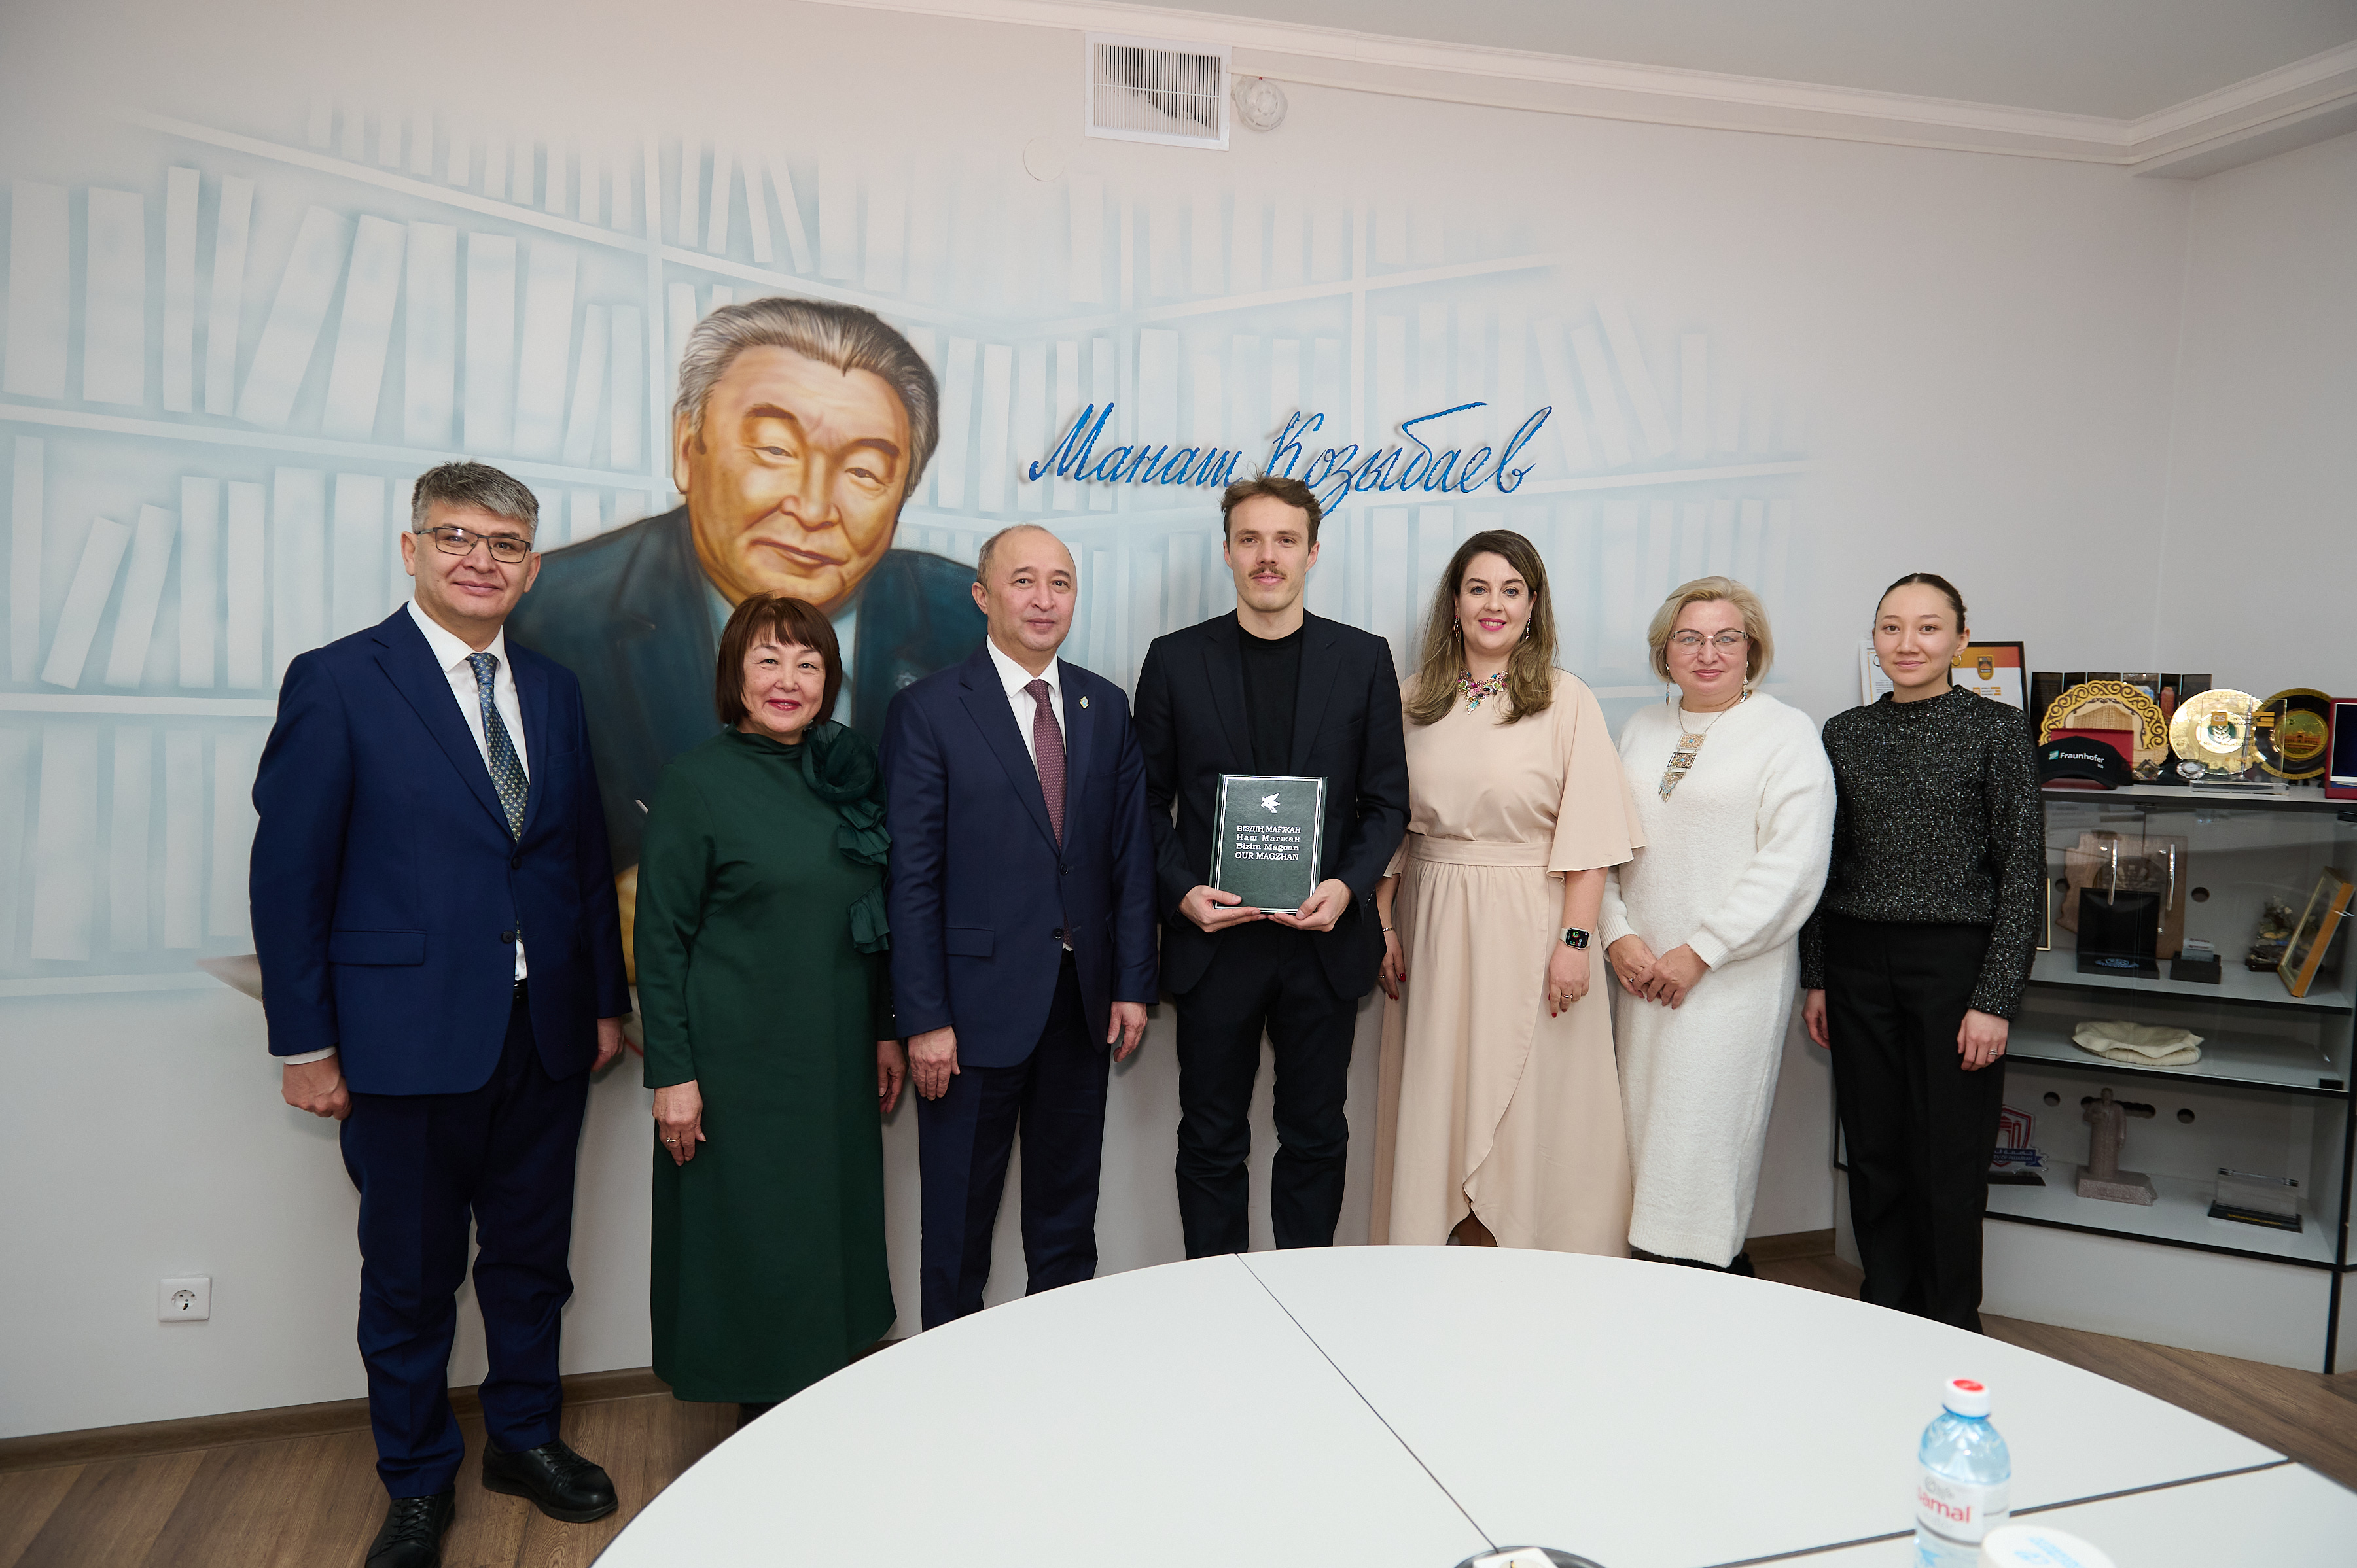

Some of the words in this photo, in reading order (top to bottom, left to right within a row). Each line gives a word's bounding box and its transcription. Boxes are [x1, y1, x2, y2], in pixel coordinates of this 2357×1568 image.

[1029, 402, 1243, 487] Манаш
[1265, 402, 1553, 519] Козыбаев
[2060, 752, 2105, 763] Fraunhofer
[1236, 825, 1264, 833] БІЗДІҢ
[1266, 826, 1302, 834] МАҒЖАН
[1261, 834, 1300, 843] Магжан
[1235, 842, 1262, 850] Bizim
[1264, 843, 1300, 852] Mağcan
[1256, 852, 1299, 861] MAGZHAN
